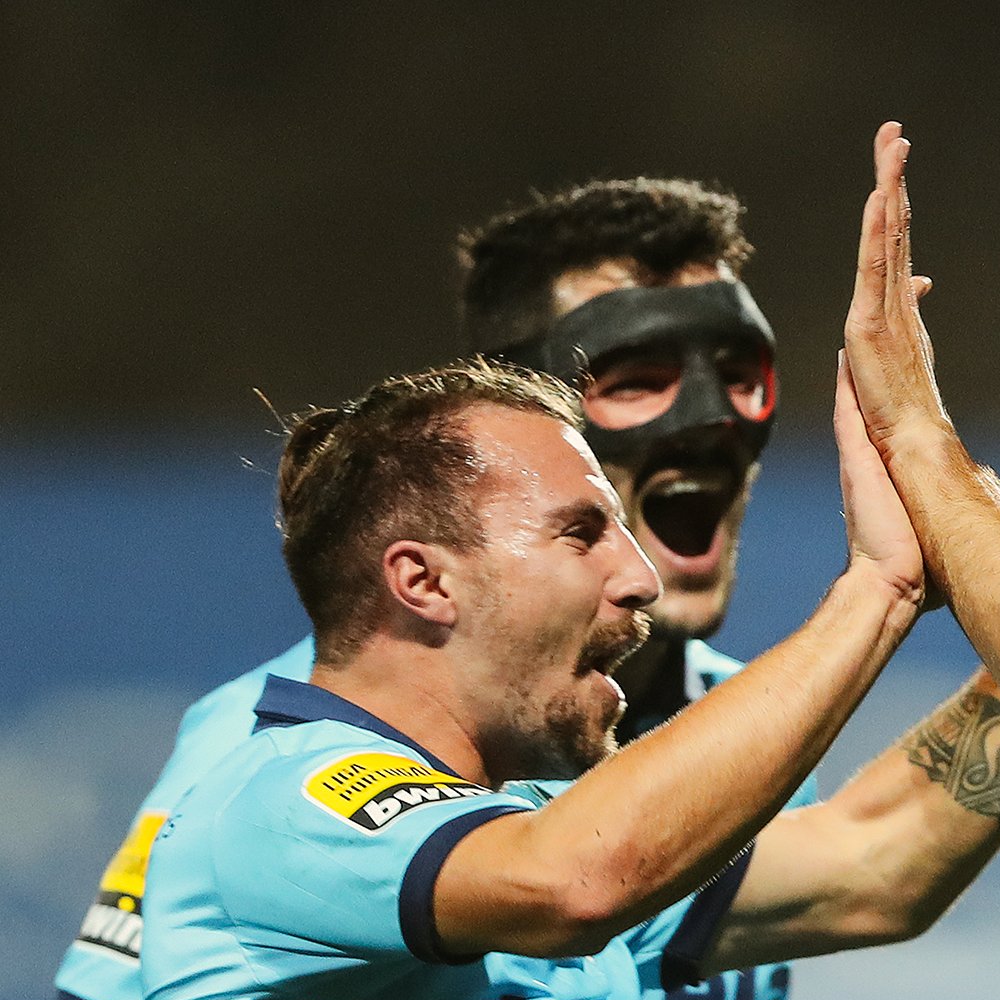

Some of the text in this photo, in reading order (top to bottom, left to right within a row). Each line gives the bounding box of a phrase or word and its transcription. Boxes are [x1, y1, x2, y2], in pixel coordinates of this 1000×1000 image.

[323, 763, 367, 792] LIGA
[339, 766, 432, 802] PORTUGAL
[362, 784, 494, 828] bwin
